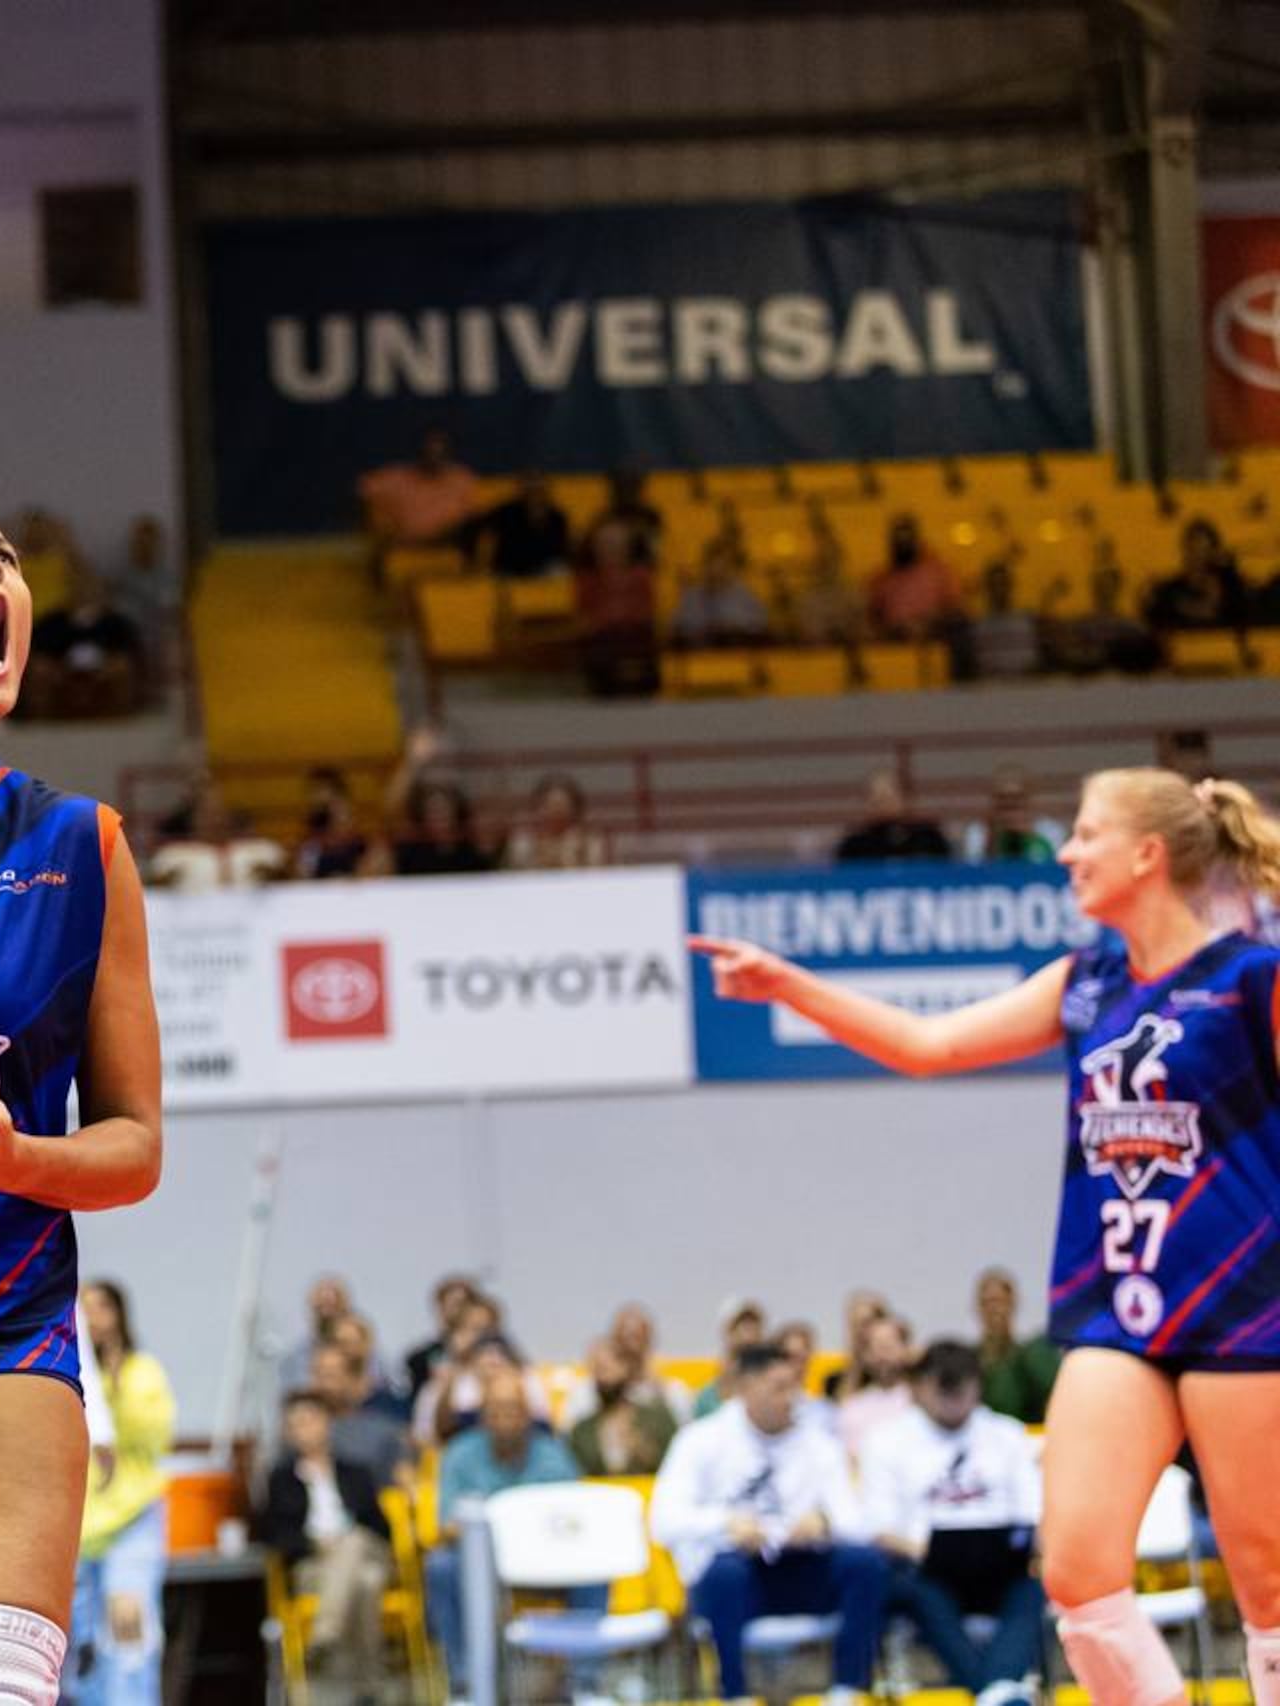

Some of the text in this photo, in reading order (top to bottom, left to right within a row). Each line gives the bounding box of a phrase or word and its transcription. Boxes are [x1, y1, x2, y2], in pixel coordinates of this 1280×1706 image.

[267, 288, 997, 401] UNIVERSAL
[421, 953, 679, 1012] TOYOTA
[1100, 1199, 1171, 1273] 27
